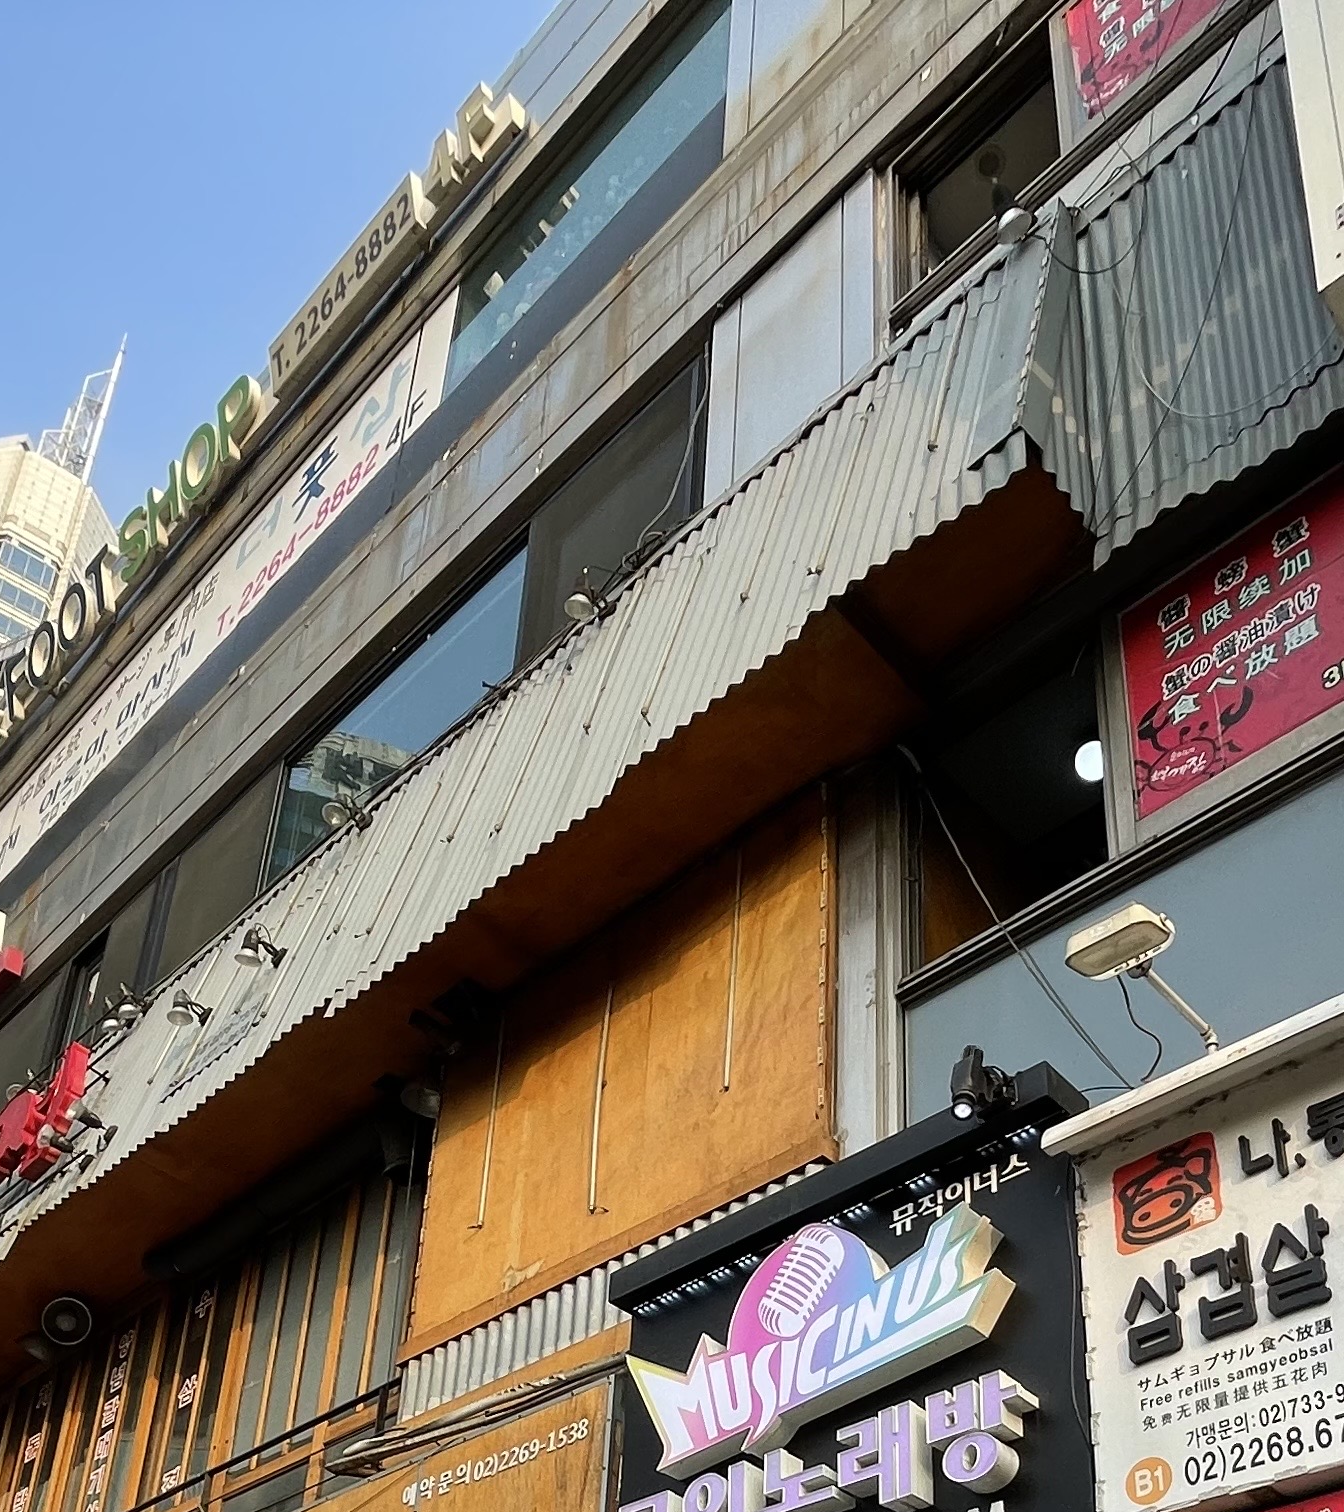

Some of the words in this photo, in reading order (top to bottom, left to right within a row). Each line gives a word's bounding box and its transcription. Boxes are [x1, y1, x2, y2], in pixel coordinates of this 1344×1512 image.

[294, 192, 413, 356] 2264-8882
[119, 374, 262, 582] SHOP
[237, 443, 380, 616] 2264-8882
[1163, 548, 1311, 659] 无限续加
[116, 629, 196, 730] 마사지
[1168, 613, 1320, 726] 食べ放題
[888, 1152, 1032, 1236] 뮤직이너스
[1123, 1201, 1334, 1367] 삼겹살
[1137, 1342, 1256, 1393] サムギョプサル
[1258, 1315, 1334, 1355] 食べ放題
[1140, 1391, 1174, 1411] Free
[1178, 1375, 1220, 1402] refills
[1226, 1337, 1334, 1384] samgyeobsal
[1141, 1362, 1329, 1432] 免费无限量提供五花肉
[473, 1418, 590, 1482] 02)2269-1538
[1133, 1464, 1165, 1497] B1
